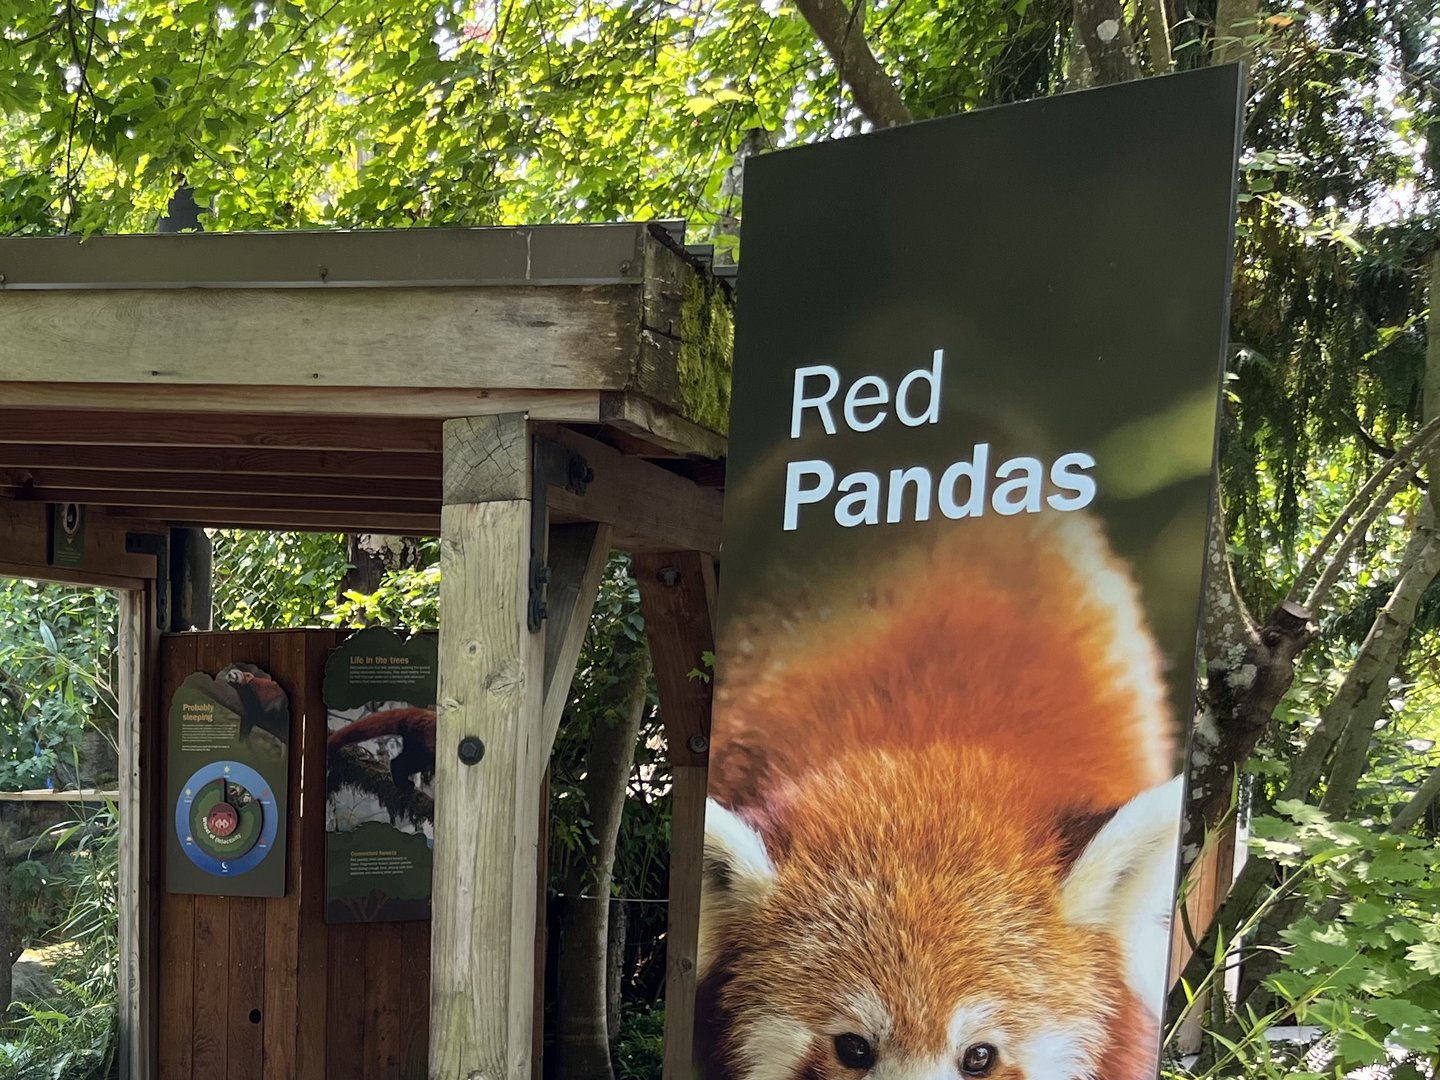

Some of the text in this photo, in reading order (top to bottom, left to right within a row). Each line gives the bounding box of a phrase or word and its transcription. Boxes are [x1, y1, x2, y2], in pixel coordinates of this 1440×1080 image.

[790, 348, 944, 439] Red
[782, 442, 1097, 531] Pandas
[350, 655, 409, 664] Life in the trees
[183, 703, 215, 713] Probably
[182, 713, 213, 723] sleeping
